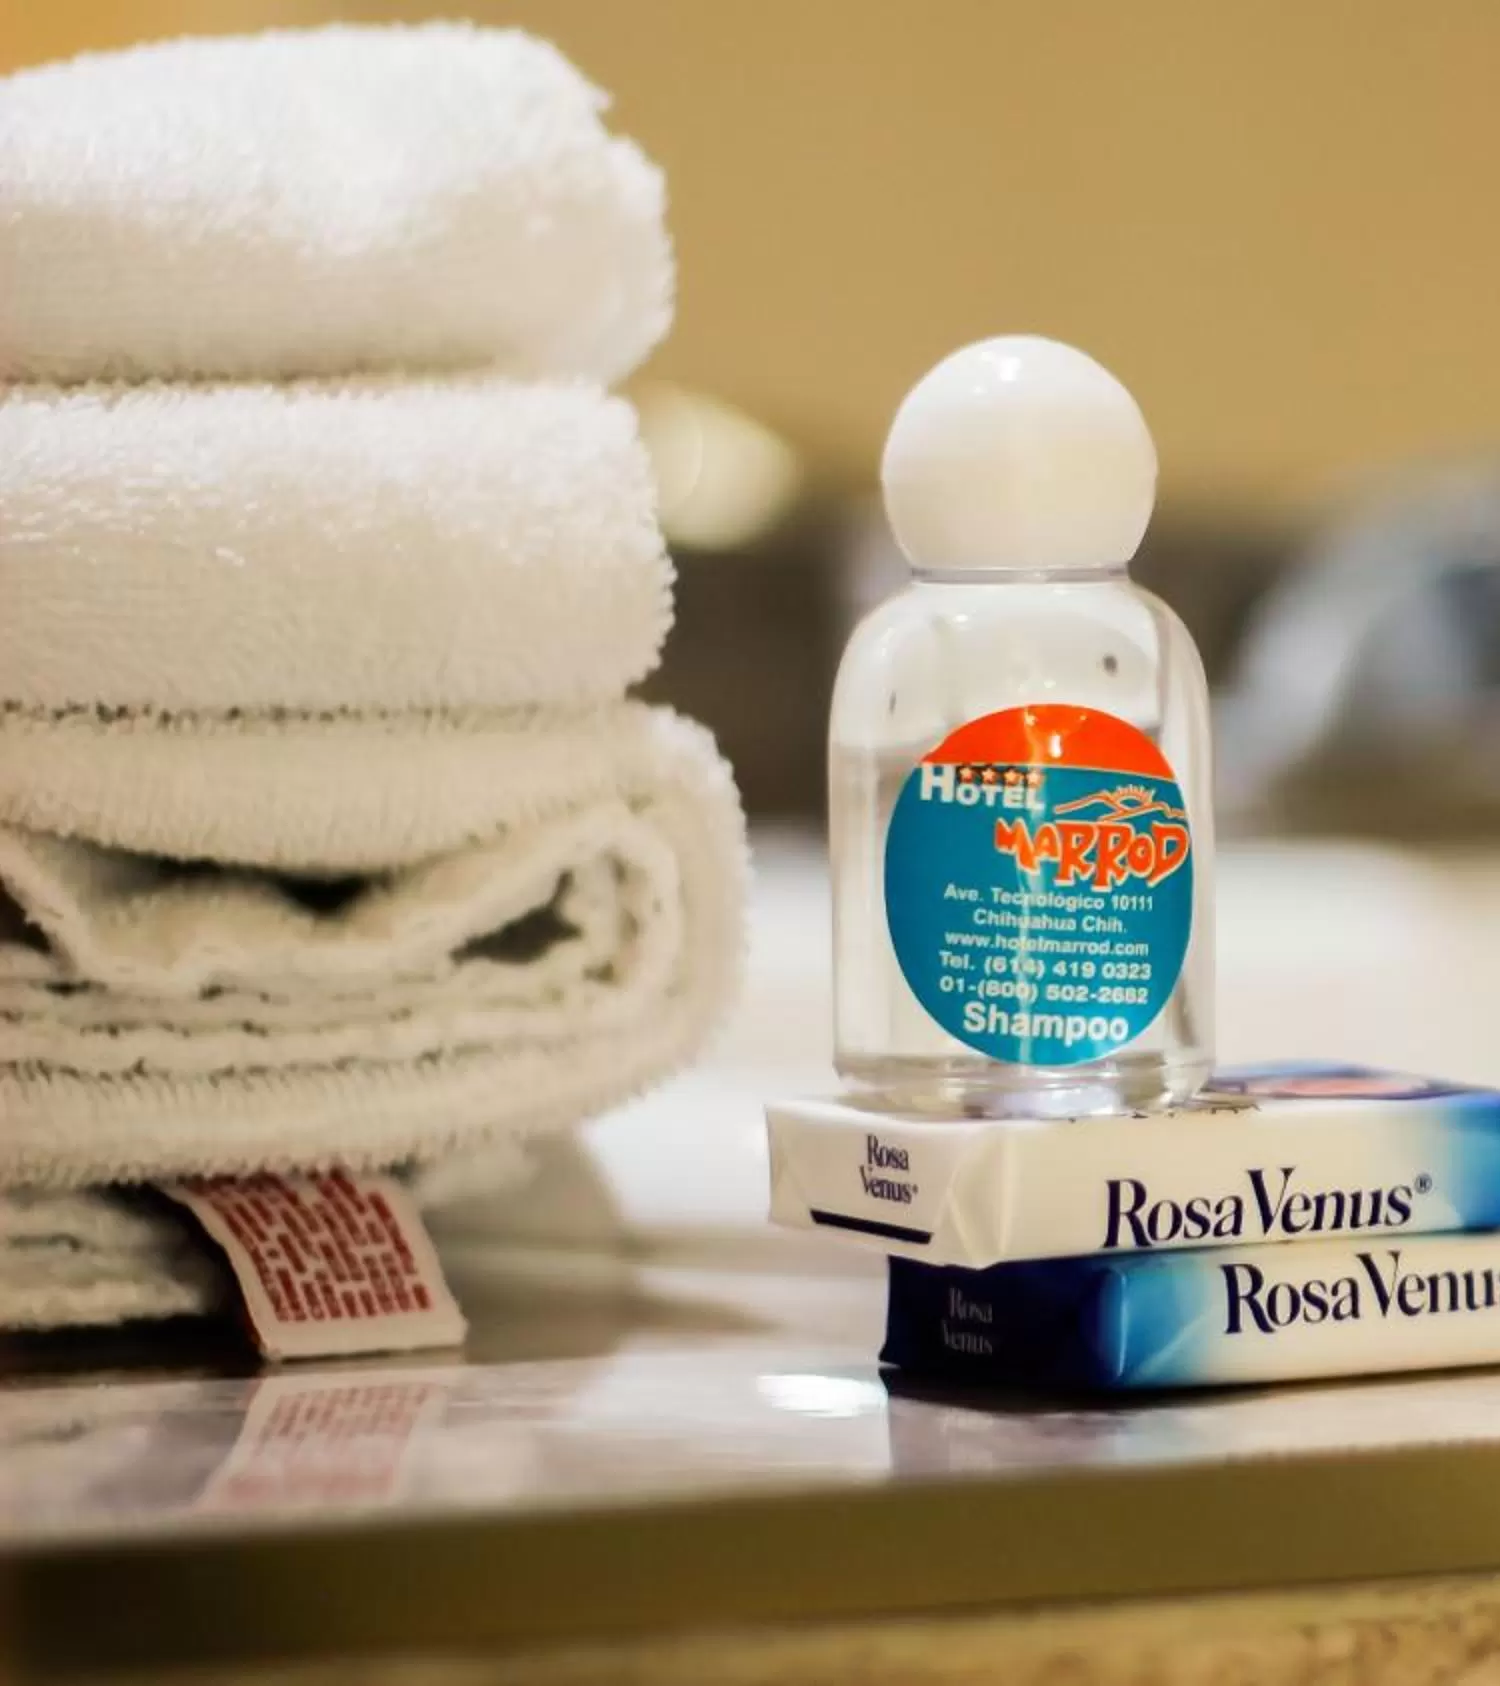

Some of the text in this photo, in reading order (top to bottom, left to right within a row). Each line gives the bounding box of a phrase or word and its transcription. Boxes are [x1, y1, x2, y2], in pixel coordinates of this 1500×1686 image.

[920, 763, 1045, 811] HOTEL
[994, 817, 1190, 892] MARROD
[943, 883, 984, 902] Ave.
[1111, 895, 1153, 912] 10111
[973, 908, 1127, 934] Chihuahua Chih.
[939, 950, 976, 971] Tel.
[1052, 960, 1097, 980] 419
[1101, 962, 1153, 981] 0323
[944, 931, 1150, 957] www.hotelmarrod.com
[963, 1001, 1130, 1048] Shampoo
[866, 1133, 910, 1172] Rosa
[1102, 1177, 1245, 1249] Rosa
[1219, 1262, 1361, 1335] Rosa
